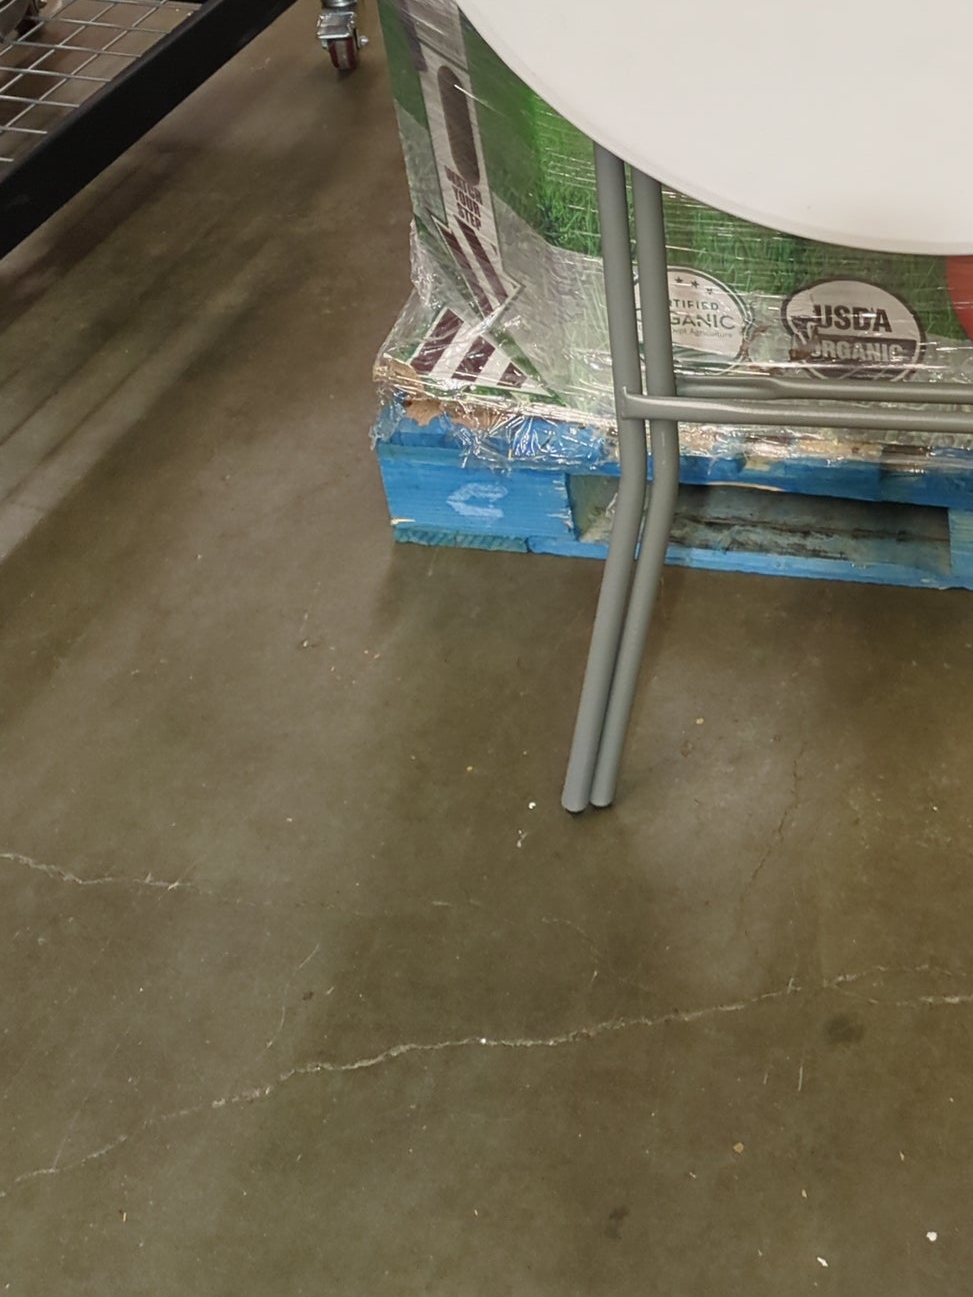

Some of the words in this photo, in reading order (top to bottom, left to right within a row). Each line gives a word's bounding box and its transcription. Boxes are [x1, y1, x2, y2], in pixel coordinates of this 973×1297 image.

[444, 165, 483, 206] WATCH
[451, 185, 481, 218] YOUR
[456, 202, 482, 231] STEP
[669, 299, 720, 311] TIFIED
[813, 304, 892, 333] USDA
[670, 312, 735, 330] GANIC
